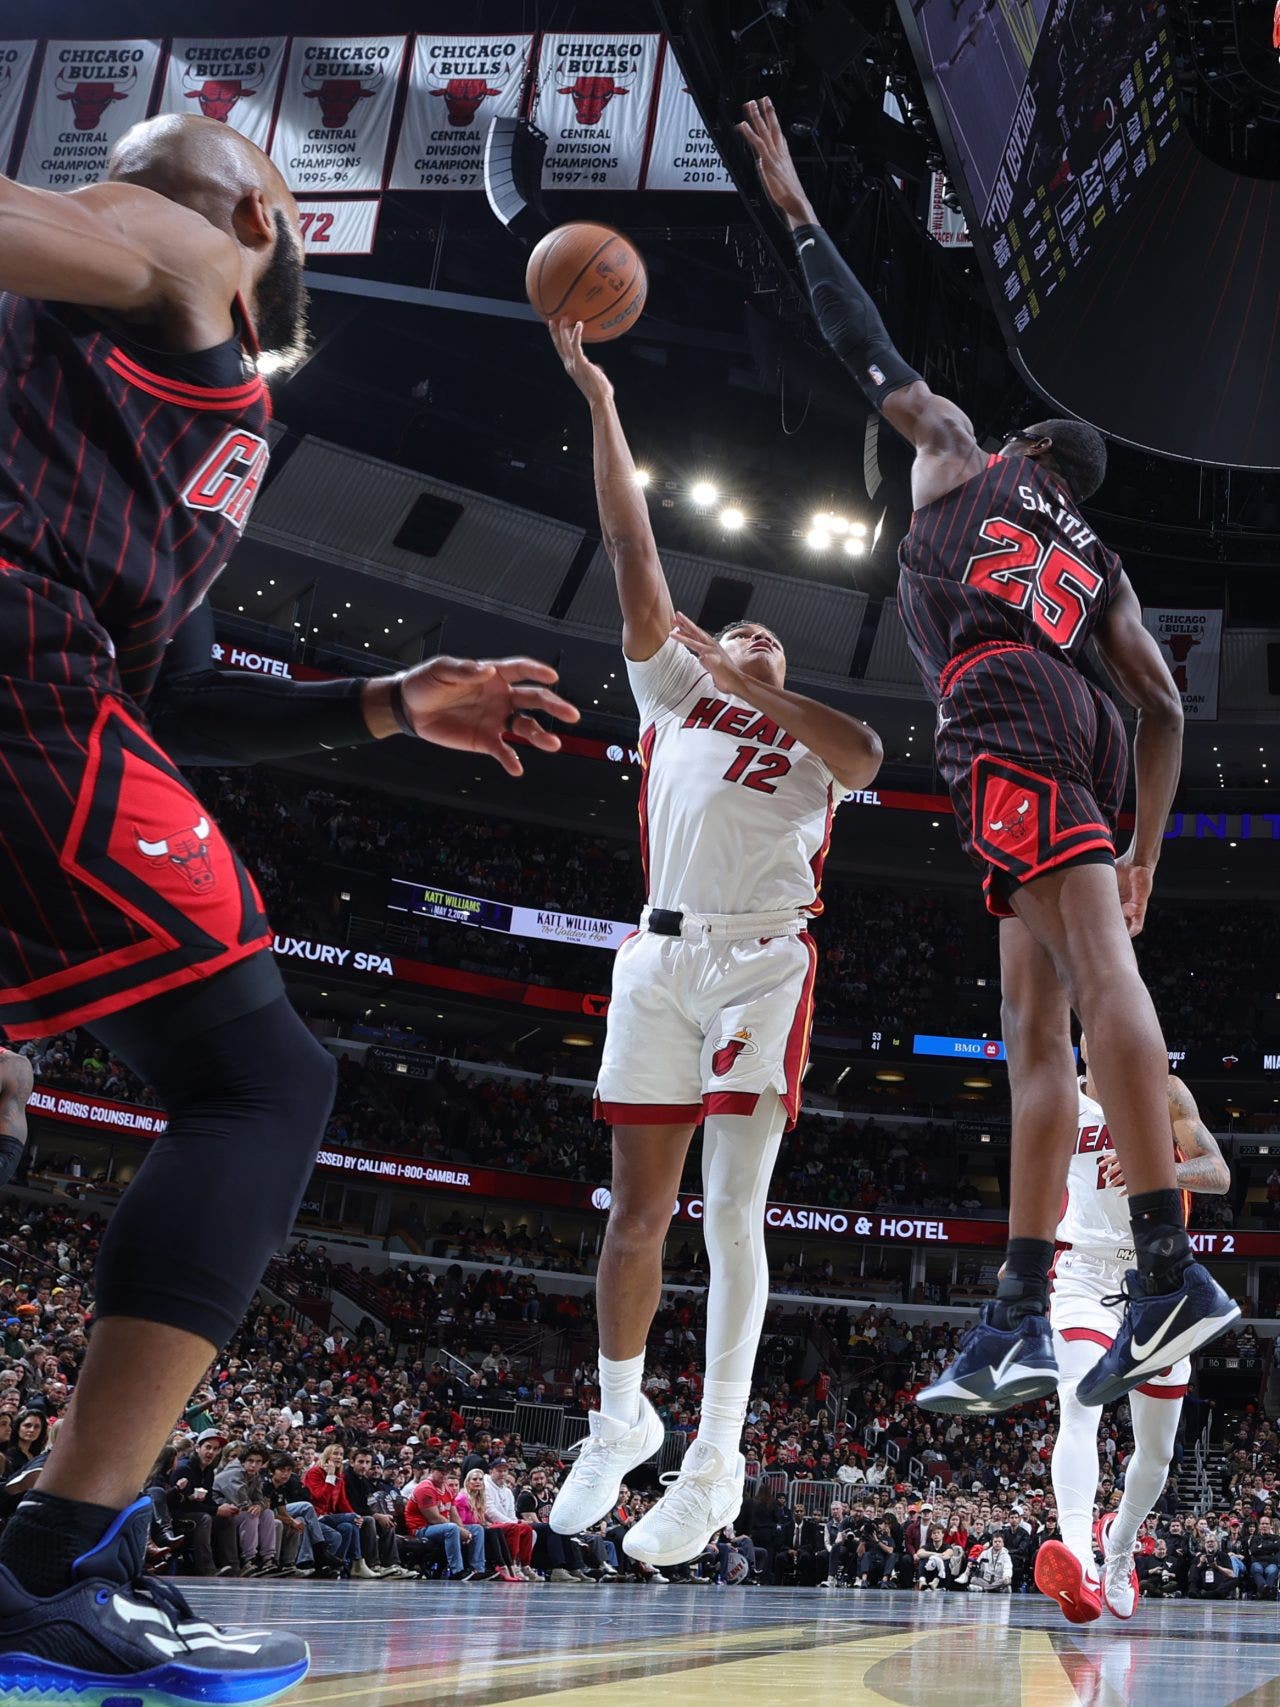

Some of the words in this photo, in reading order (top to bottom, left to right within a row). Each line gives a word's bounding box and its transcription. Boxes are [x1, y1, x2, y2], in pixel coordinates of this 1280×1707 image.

[59, 50, 143, 63] CHICAGO
[185, 47, 270, 60] CHICAGO
[305, 46, 389, 60] CHICAGO
[430, 44, 515, 58] CHICAGO
[557, 44, 642, 57] CHICAGO
[68, 65, 129, 79] BULLS
[195, 62, 255, 76] BULLS
[314, 63, 375, 76] BULLS
[440, 62, 501, 75] BULLS
[568, 60, 628, 74] BULLS
[58, 133, 108, 143] CENTRAL
[308, 130, 357, 139] CENTRAL
[431, 131, 481, 141] CENTRAL
[561, 129, 611, 139] CENTRAL
[53, 146, 107, 156] DIVISION
[303, 143, 355, 154] DIVISION
[426, 146, 480, 155] DIVISION
[556, 144, 611, 153] DIVISION
[290, 157, 361, 168] CHAMPIONS
[545, 158, 618, 168] CHAMPIONS
[299, 213, 334, 241] 72
[1018, 485, 1097, 549] SMITH
[962, 517, 1104, 649] 25
[1159, 614, 1206, 624] CHICAGO
[1165, 624, 1199, 633] BULLS
[211, 643, 224, 660] &
[230, 649, 292, 679] HOTEL
[682, 696, 798, 750] HEA
[722, 745, 792, 794] 12
[841, 790, 881, 806] OTEL
[424, 890, 444, 903] KATT
[445, 895, 481, 913] WILLIAMS
[537, 912, 561, 927] KATT
[565, 915, 613, 935] WILLIAMS
[268, 935, 351, 965] UXURY
[353, 952, 393, 975] SPA
[954, 1043, 981, 1053] BMO
[58, 1099, 88, 1118] CRISIS
[90, 1106, 153, 1130] COUNSELING
[344, 1156, 356, 1169] BY
[357, 1158, 395, 1175] CALLING
[397, 1164, 470, 1186] 1-800-GAMBLER.
[766, 1208, 848, 1233] CASINO
[854, 1217, 874, 1235] &
[880, 1220, 948, 1240] HOTEL
[1189, 1235, 1217, 1252] XIT
[1223, 1235, 1235, 1252] 2
